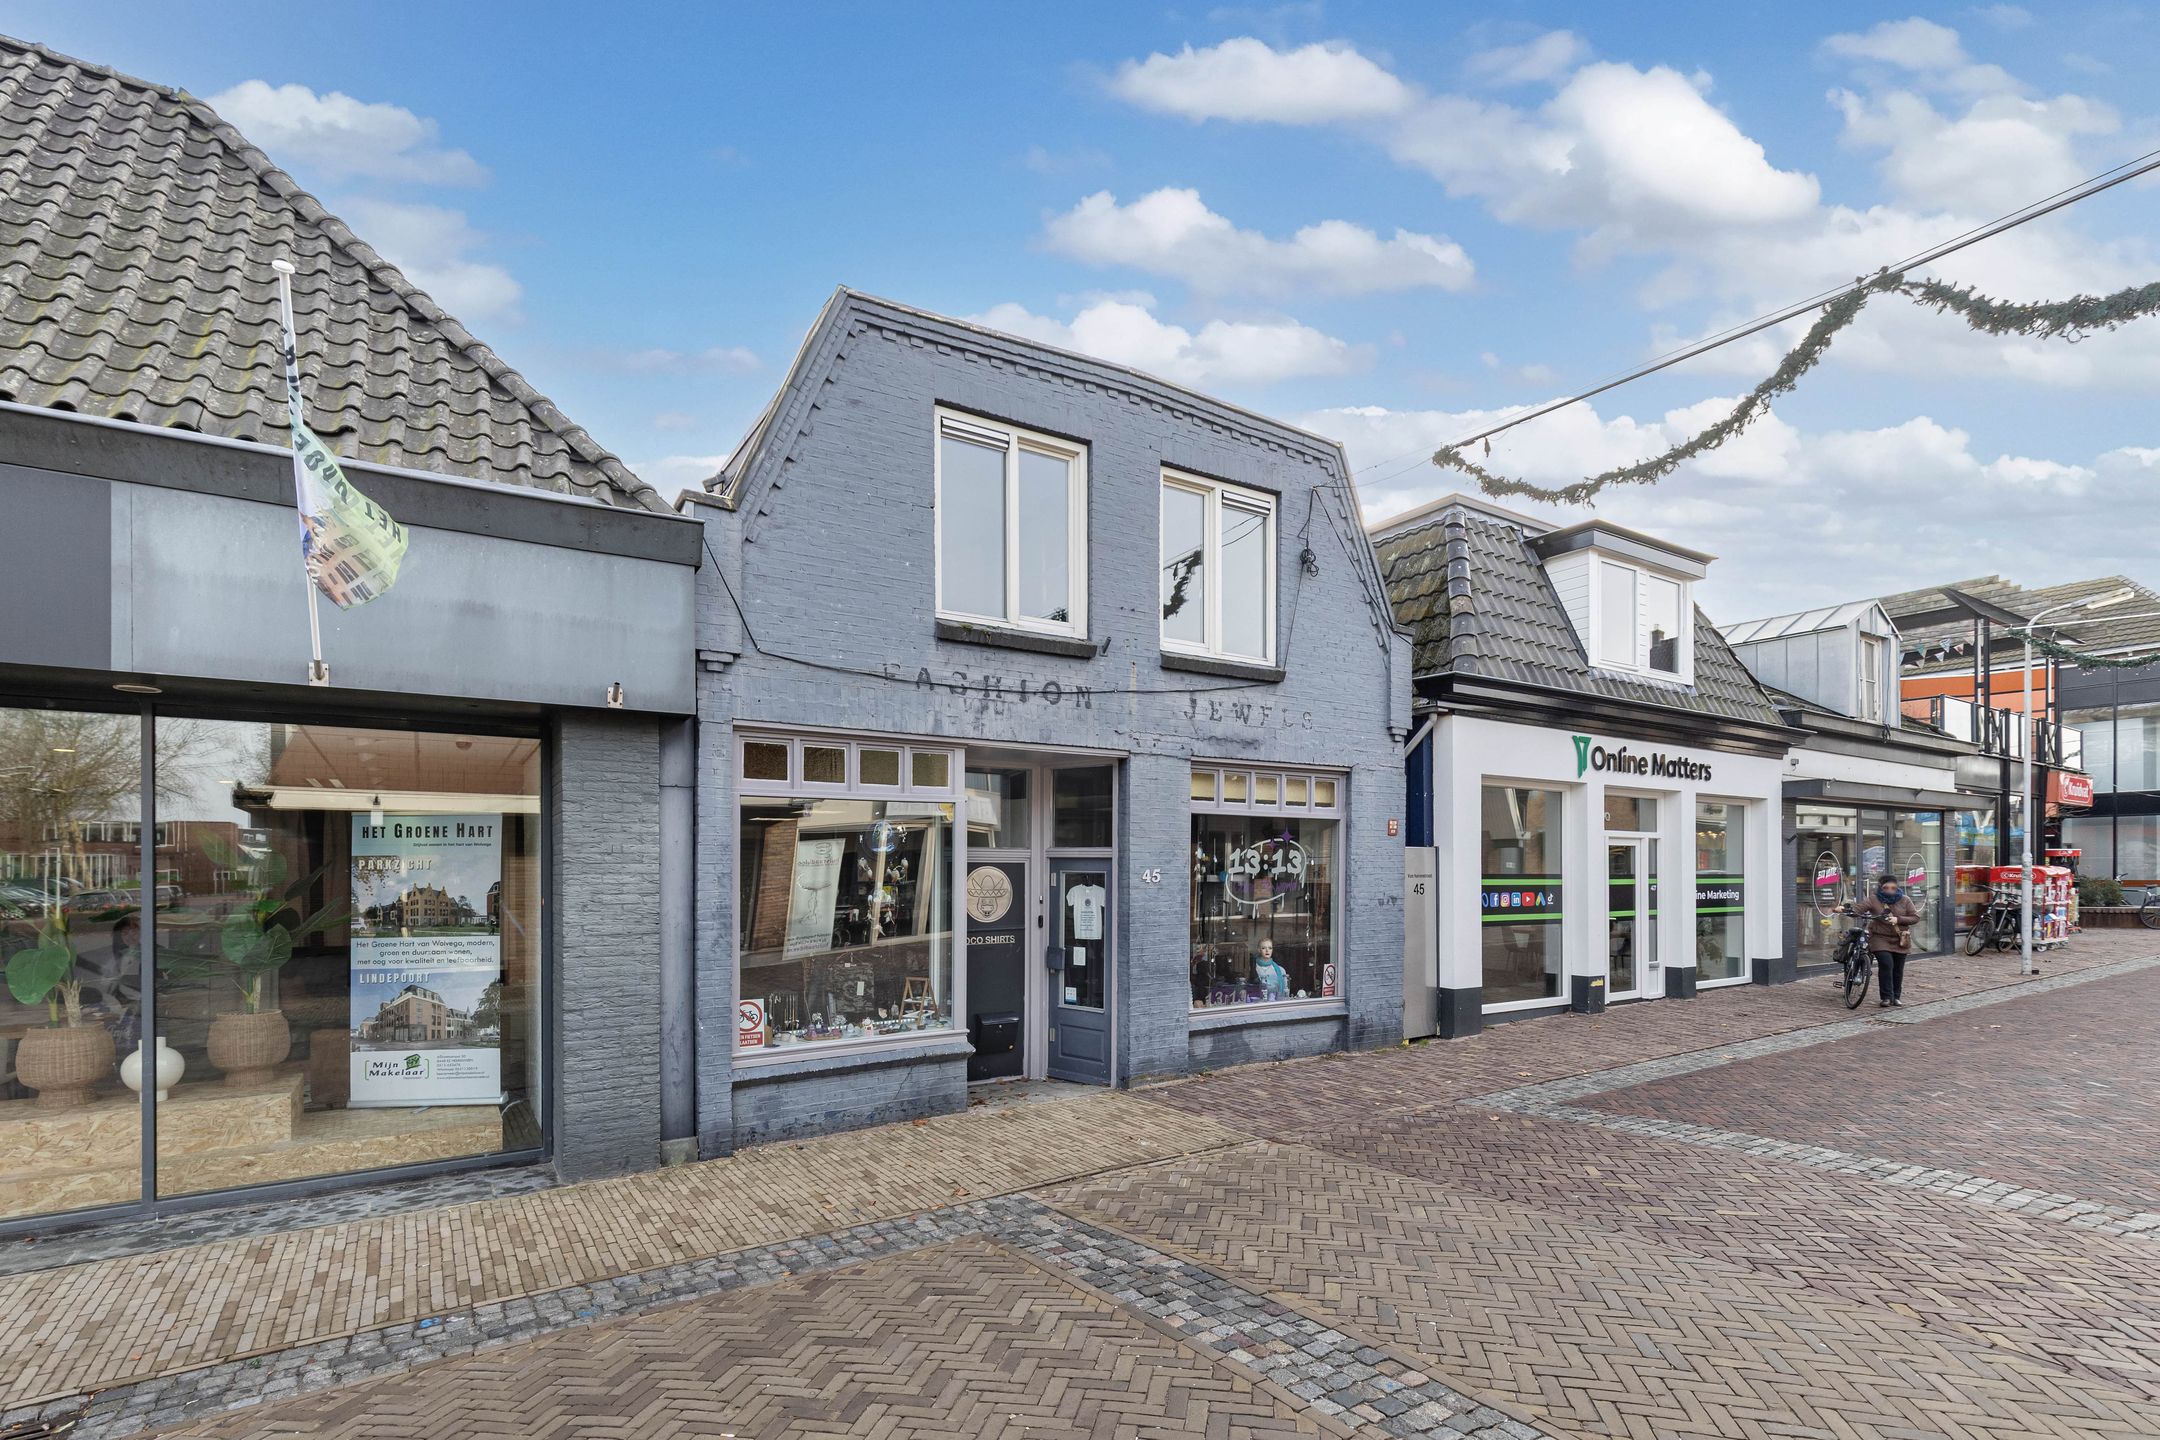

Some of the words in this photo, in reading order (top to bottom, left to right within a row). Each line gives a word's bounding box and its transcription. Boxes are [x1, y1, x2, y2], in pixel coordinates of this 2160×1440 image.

[1591, 745, 1649, 776] Online
[1651, 752, 1712, 781] Matters
[362, 826, 386, 839] HET
[394, 823, 448, 839] GROENE
[456, 822, 493, 838] HART
[1228, 848, 1302, 878] 13:13
[1142, 868, 1161, 883] 45
[1413, 883, 1425, 896] 45
[1695, 890, 1706, 900] ine
[1707, 888, 1740, 901] Marketing
[985, 935, 1016, 944] SHIRTS
[359, 971, 431, 985] LINDEPOORT
[372, 1061, 399, 1070] Mijn
[369, 1069, 424, 1077] Makelaar
